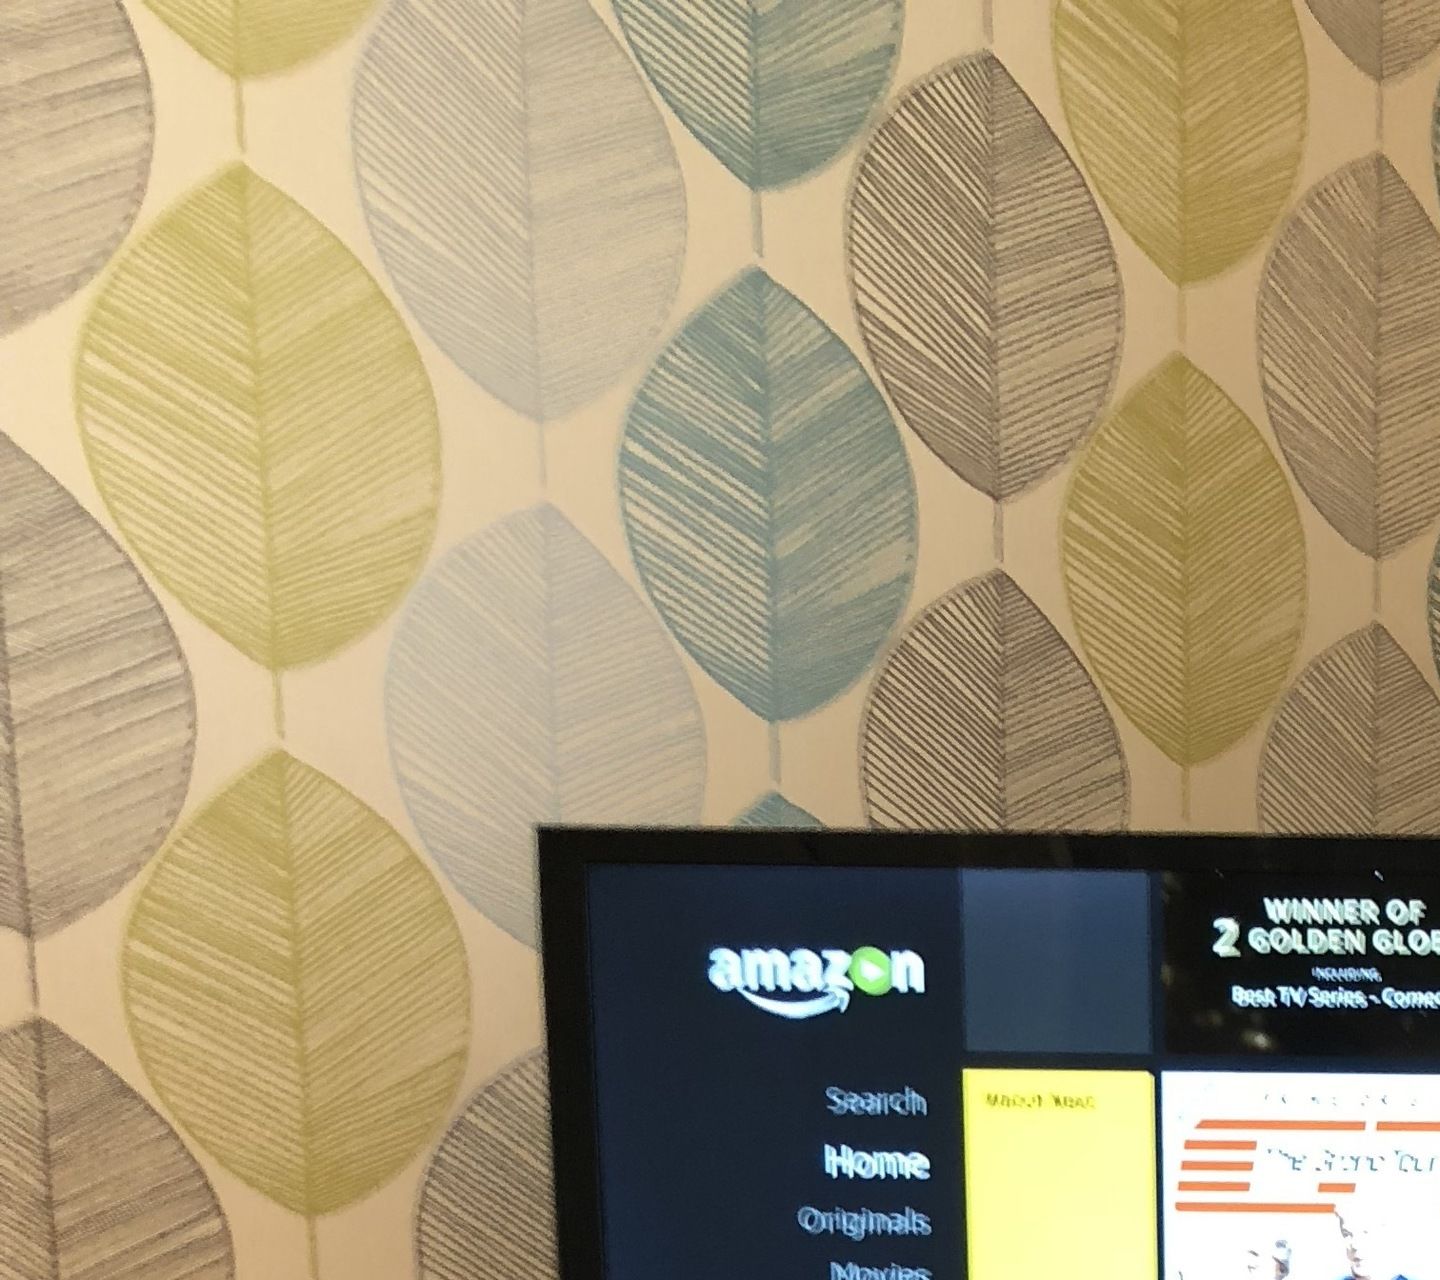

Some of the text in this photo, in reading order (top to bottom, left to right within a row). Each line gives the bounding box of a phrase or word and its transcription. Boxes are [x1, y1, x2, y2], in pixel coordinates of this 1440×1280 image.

[1263, 897, 1427, 926] WINNER OF
[1212, 917, 1241, 958] 2
[1248, 927, 1366, 955] GOLDEN
[708, 946, 926, 997] amazon
[1231, 985, 1277, 1008] Best
[1277, 986, 1309, 1009] TV
[1308, 986, 1369, 1010] Series
[825, 1085, 928, 1116] Search
[824, 1143, 931, 1180] Home
[798, 1206, 932, 1241] Originals
